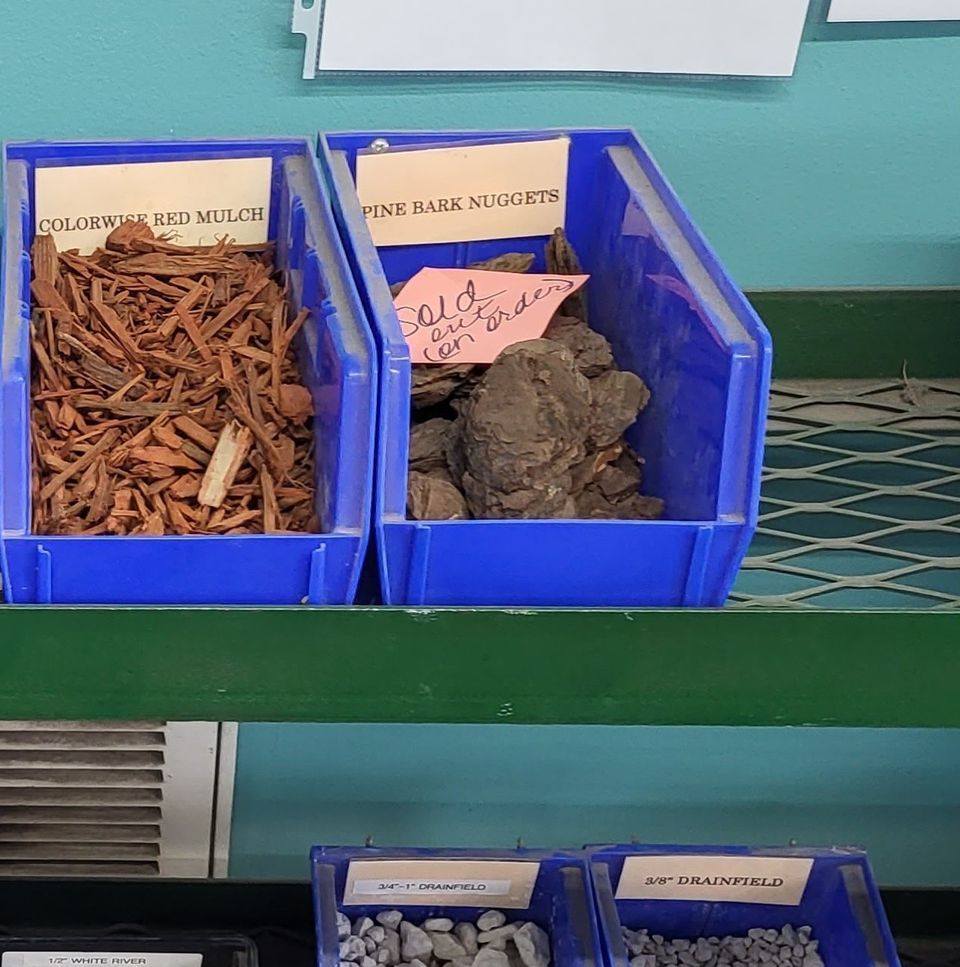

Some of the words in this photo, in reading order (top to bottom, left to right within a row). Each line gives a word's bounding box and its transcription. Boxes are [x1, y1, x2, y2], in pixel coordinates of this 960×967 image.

[362, 203, 407, 219] PINE
[412, 197, 463, 215] BARK
[468, 188, 560, 211] NUGGETS
[153, 211, 190, 227] RED
[196, 207, 264, 225] MULCH
[418, 883, 486, 891] DRAINFIELD
[645, 876, 674, 885] 3/8"
[677, 876, 784, 888] DRAINFIELD
[71, 957, 108, 965] WHITE
